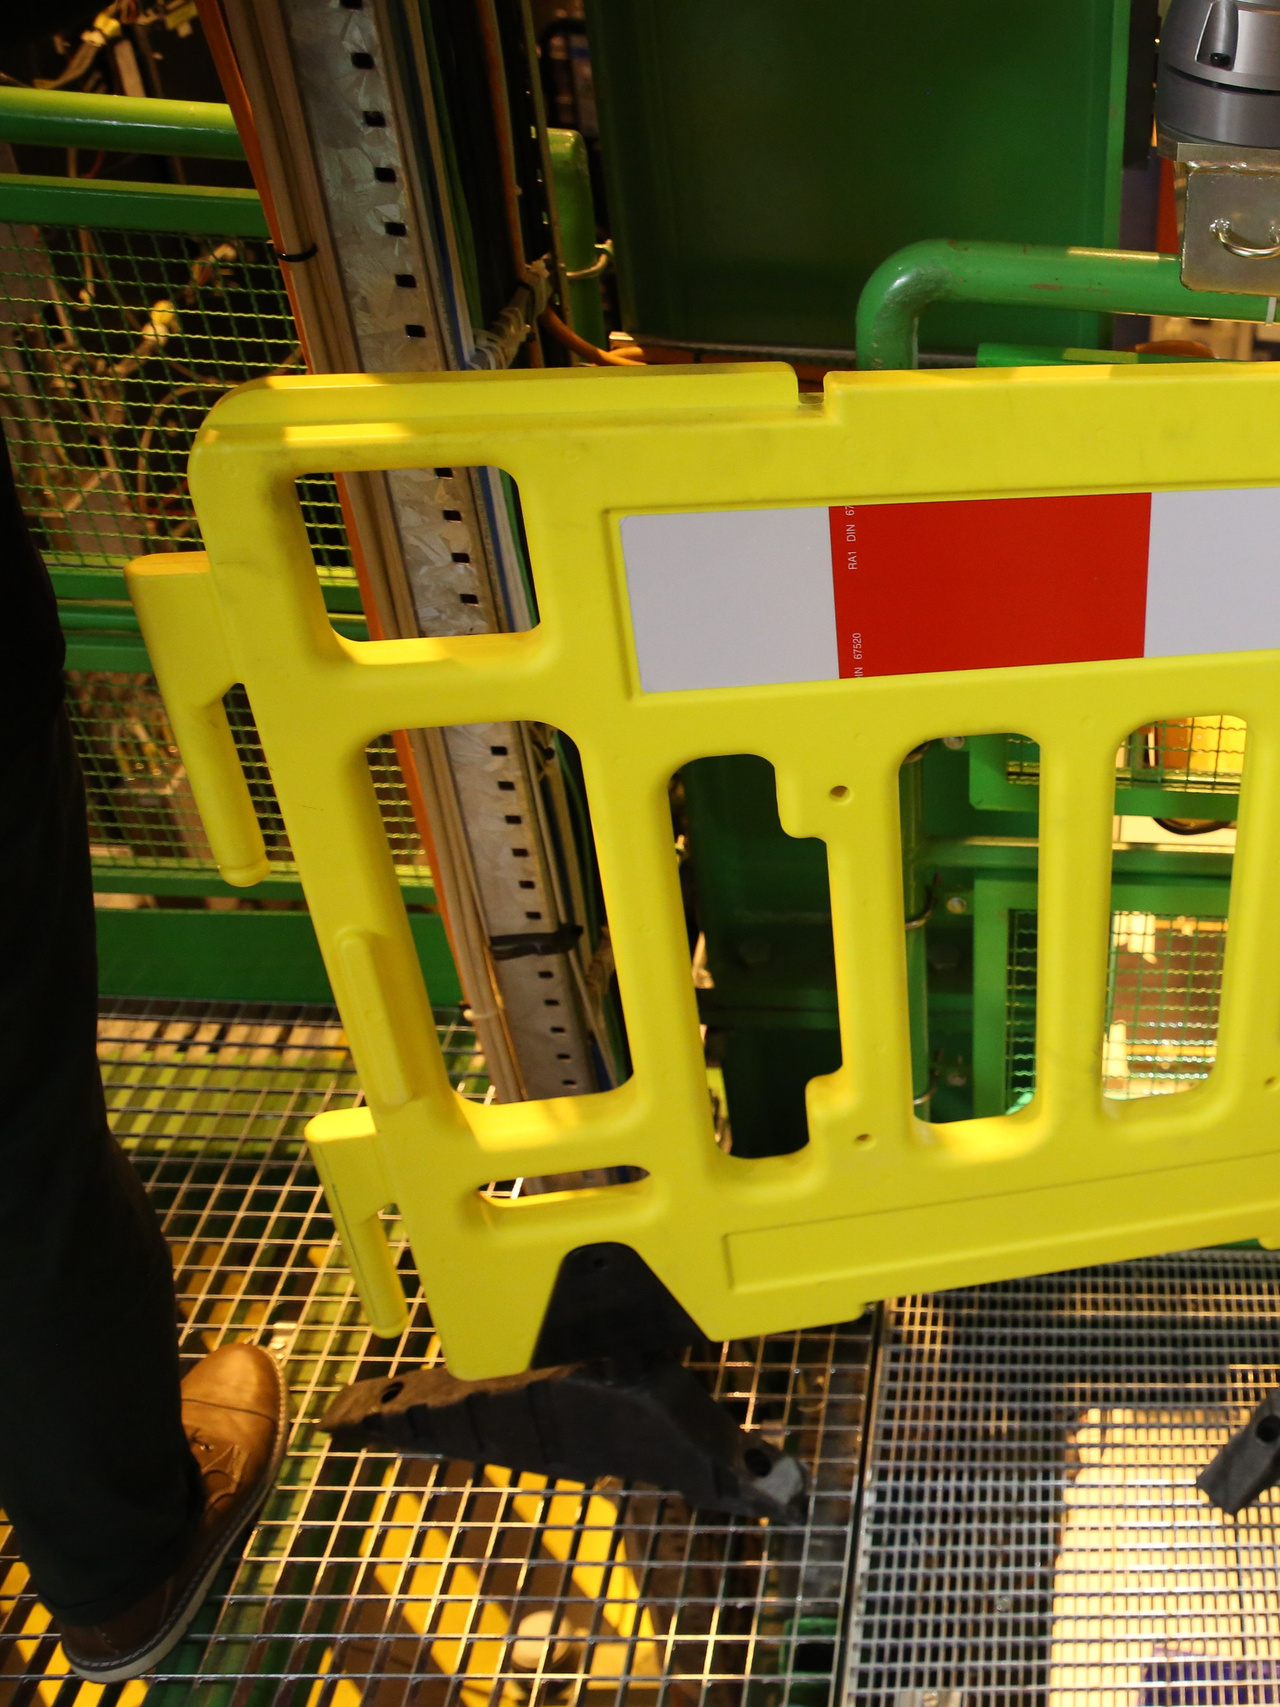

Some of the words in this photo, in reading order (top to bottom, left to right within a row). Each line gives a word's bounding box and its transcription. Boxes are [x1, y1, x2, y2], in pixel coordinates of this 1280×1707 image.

[846, 524, 856, 542] DIN
[848, 551, 858, 570] RA1
[852, 632, 863, 660] 67520
[854, 667, 864, 677] IN
